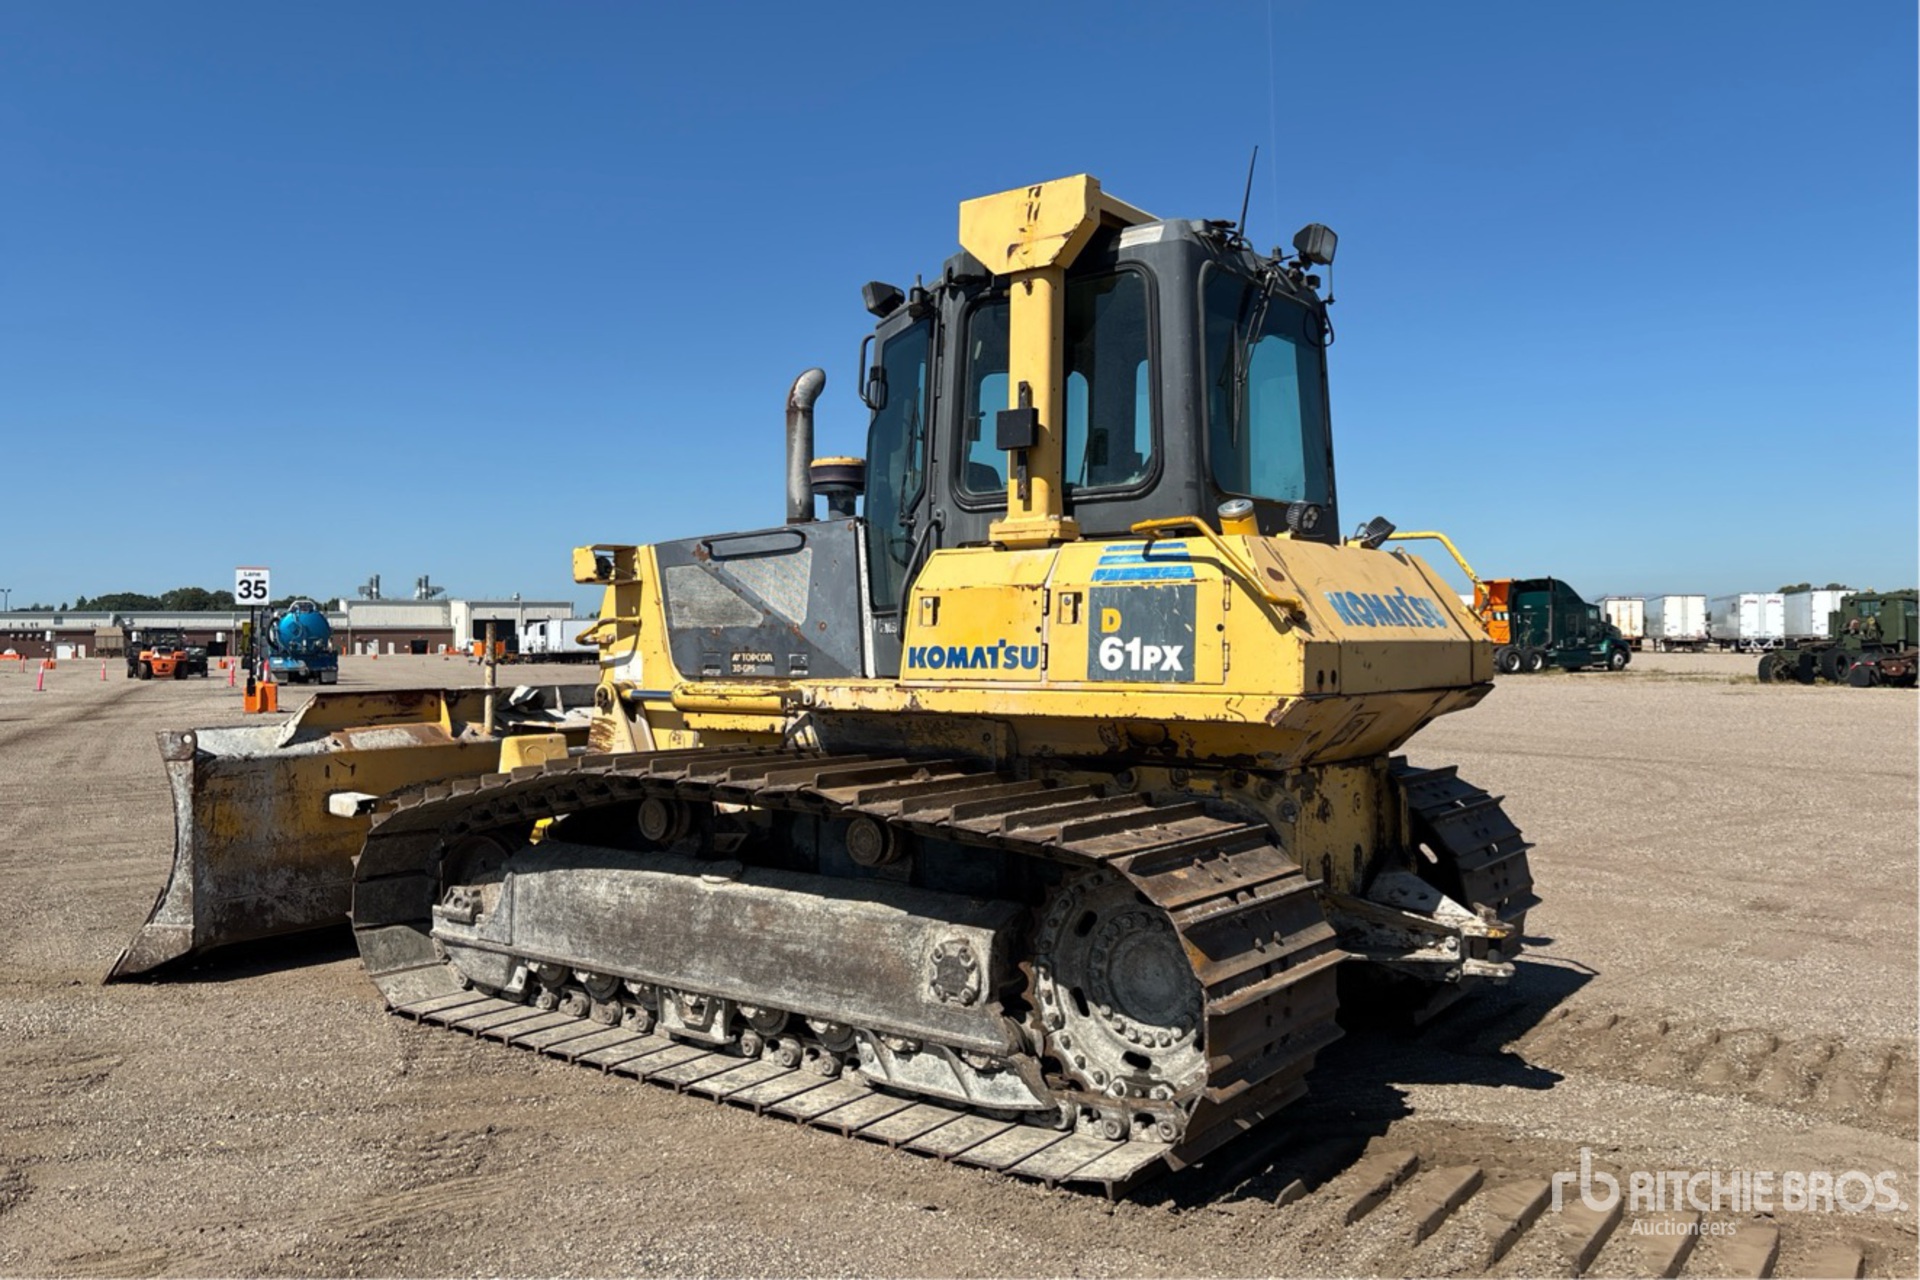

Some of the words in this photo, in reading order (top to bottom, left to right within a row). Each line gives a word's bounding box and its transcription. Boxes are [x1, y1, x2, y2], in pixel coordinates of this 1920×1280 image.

[238, 579, 267, 599] 35
[1101, 607, 1122, 633] D
[1324, 586, 1448, 628] KOMATSU
[742, 652, 773, 662] TOPCON
[908, 638, 1039, 669] KOMATSU
[1099, 636, 1184, 671] 61PX
